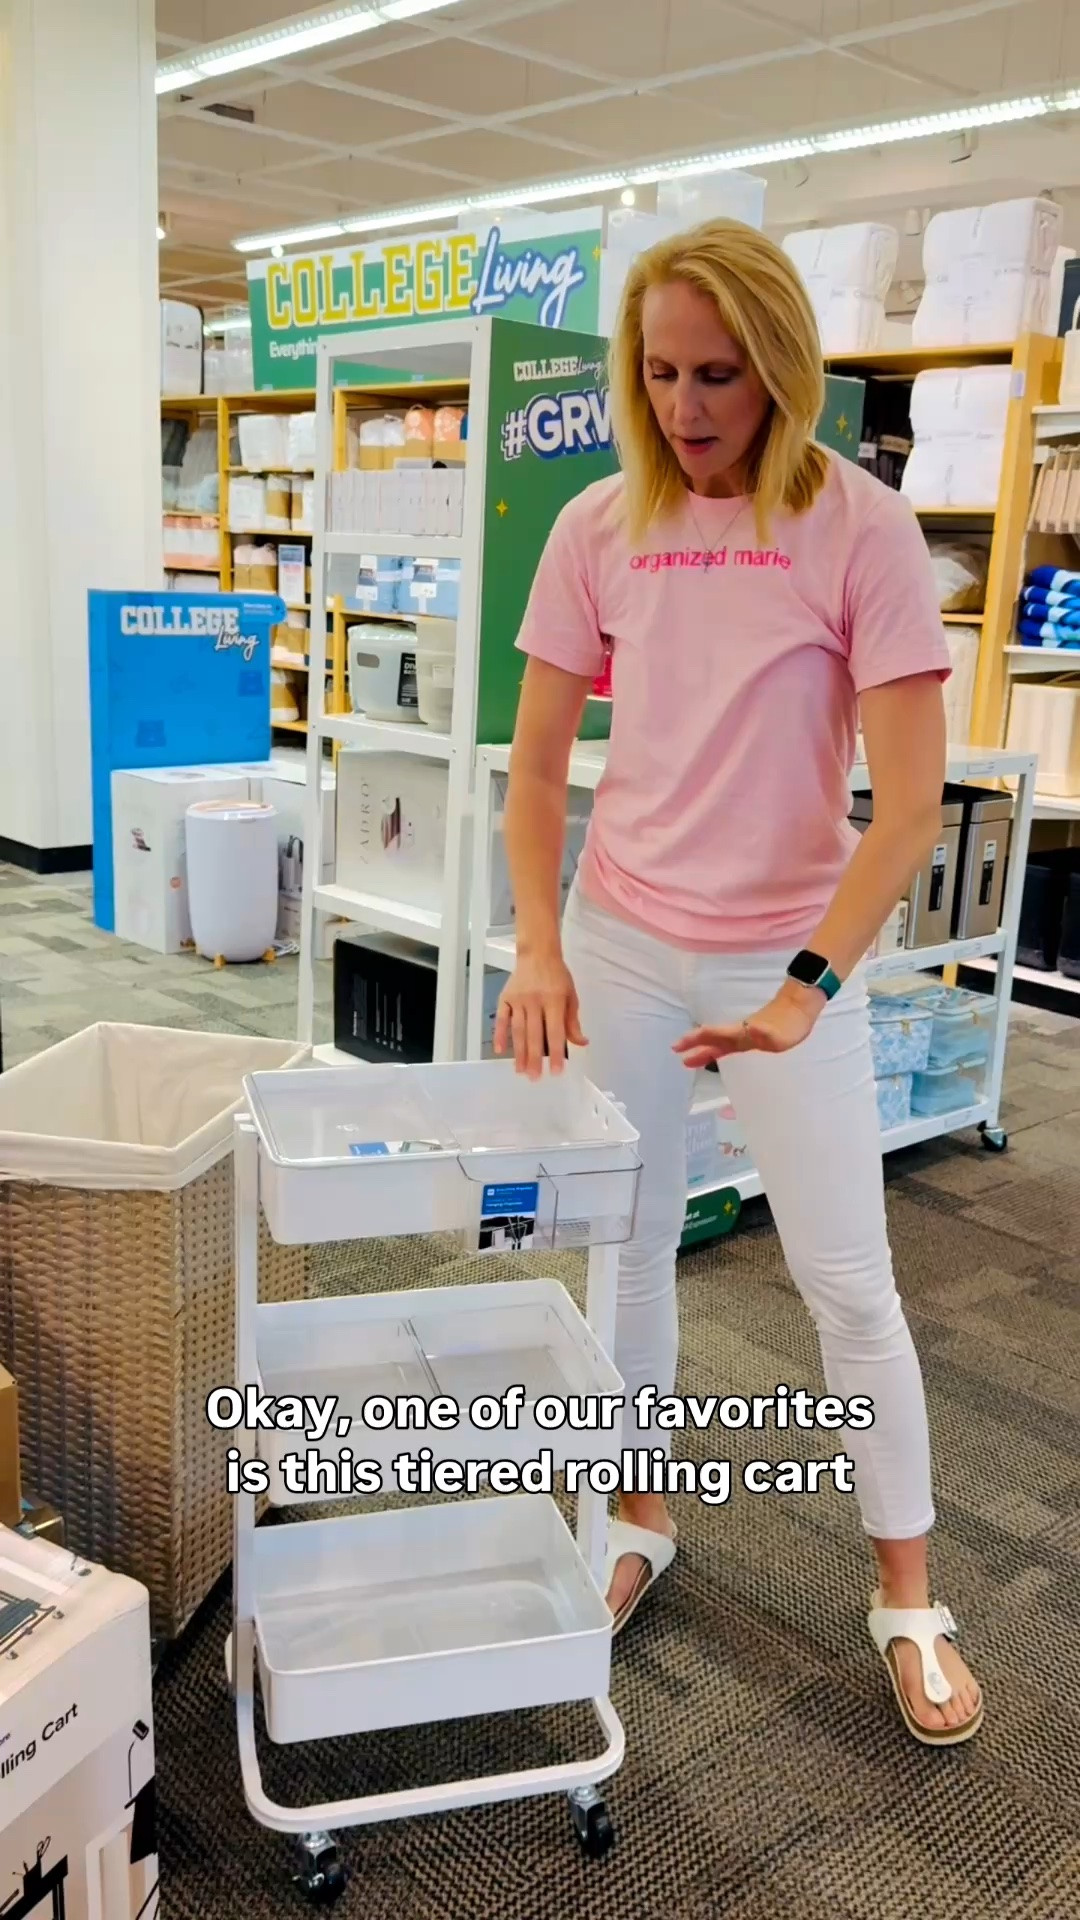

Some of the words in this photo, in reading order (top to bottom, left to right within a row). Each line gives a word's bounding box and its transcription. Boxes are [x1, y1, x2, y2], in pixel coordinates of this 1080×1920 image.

[265, 233, 480, 331] COLLEGE
[471, 227, 584, 328] Living
[513, 356, 579, 382] COLLEGE
[629, 546, 727, 573] organized
[733, 548, 792, 570] marie
[120, 605, 240, 636] COLLEGE
[215, 625, 260, 661] Living
[41, 1703, 78, 1742] Cart
